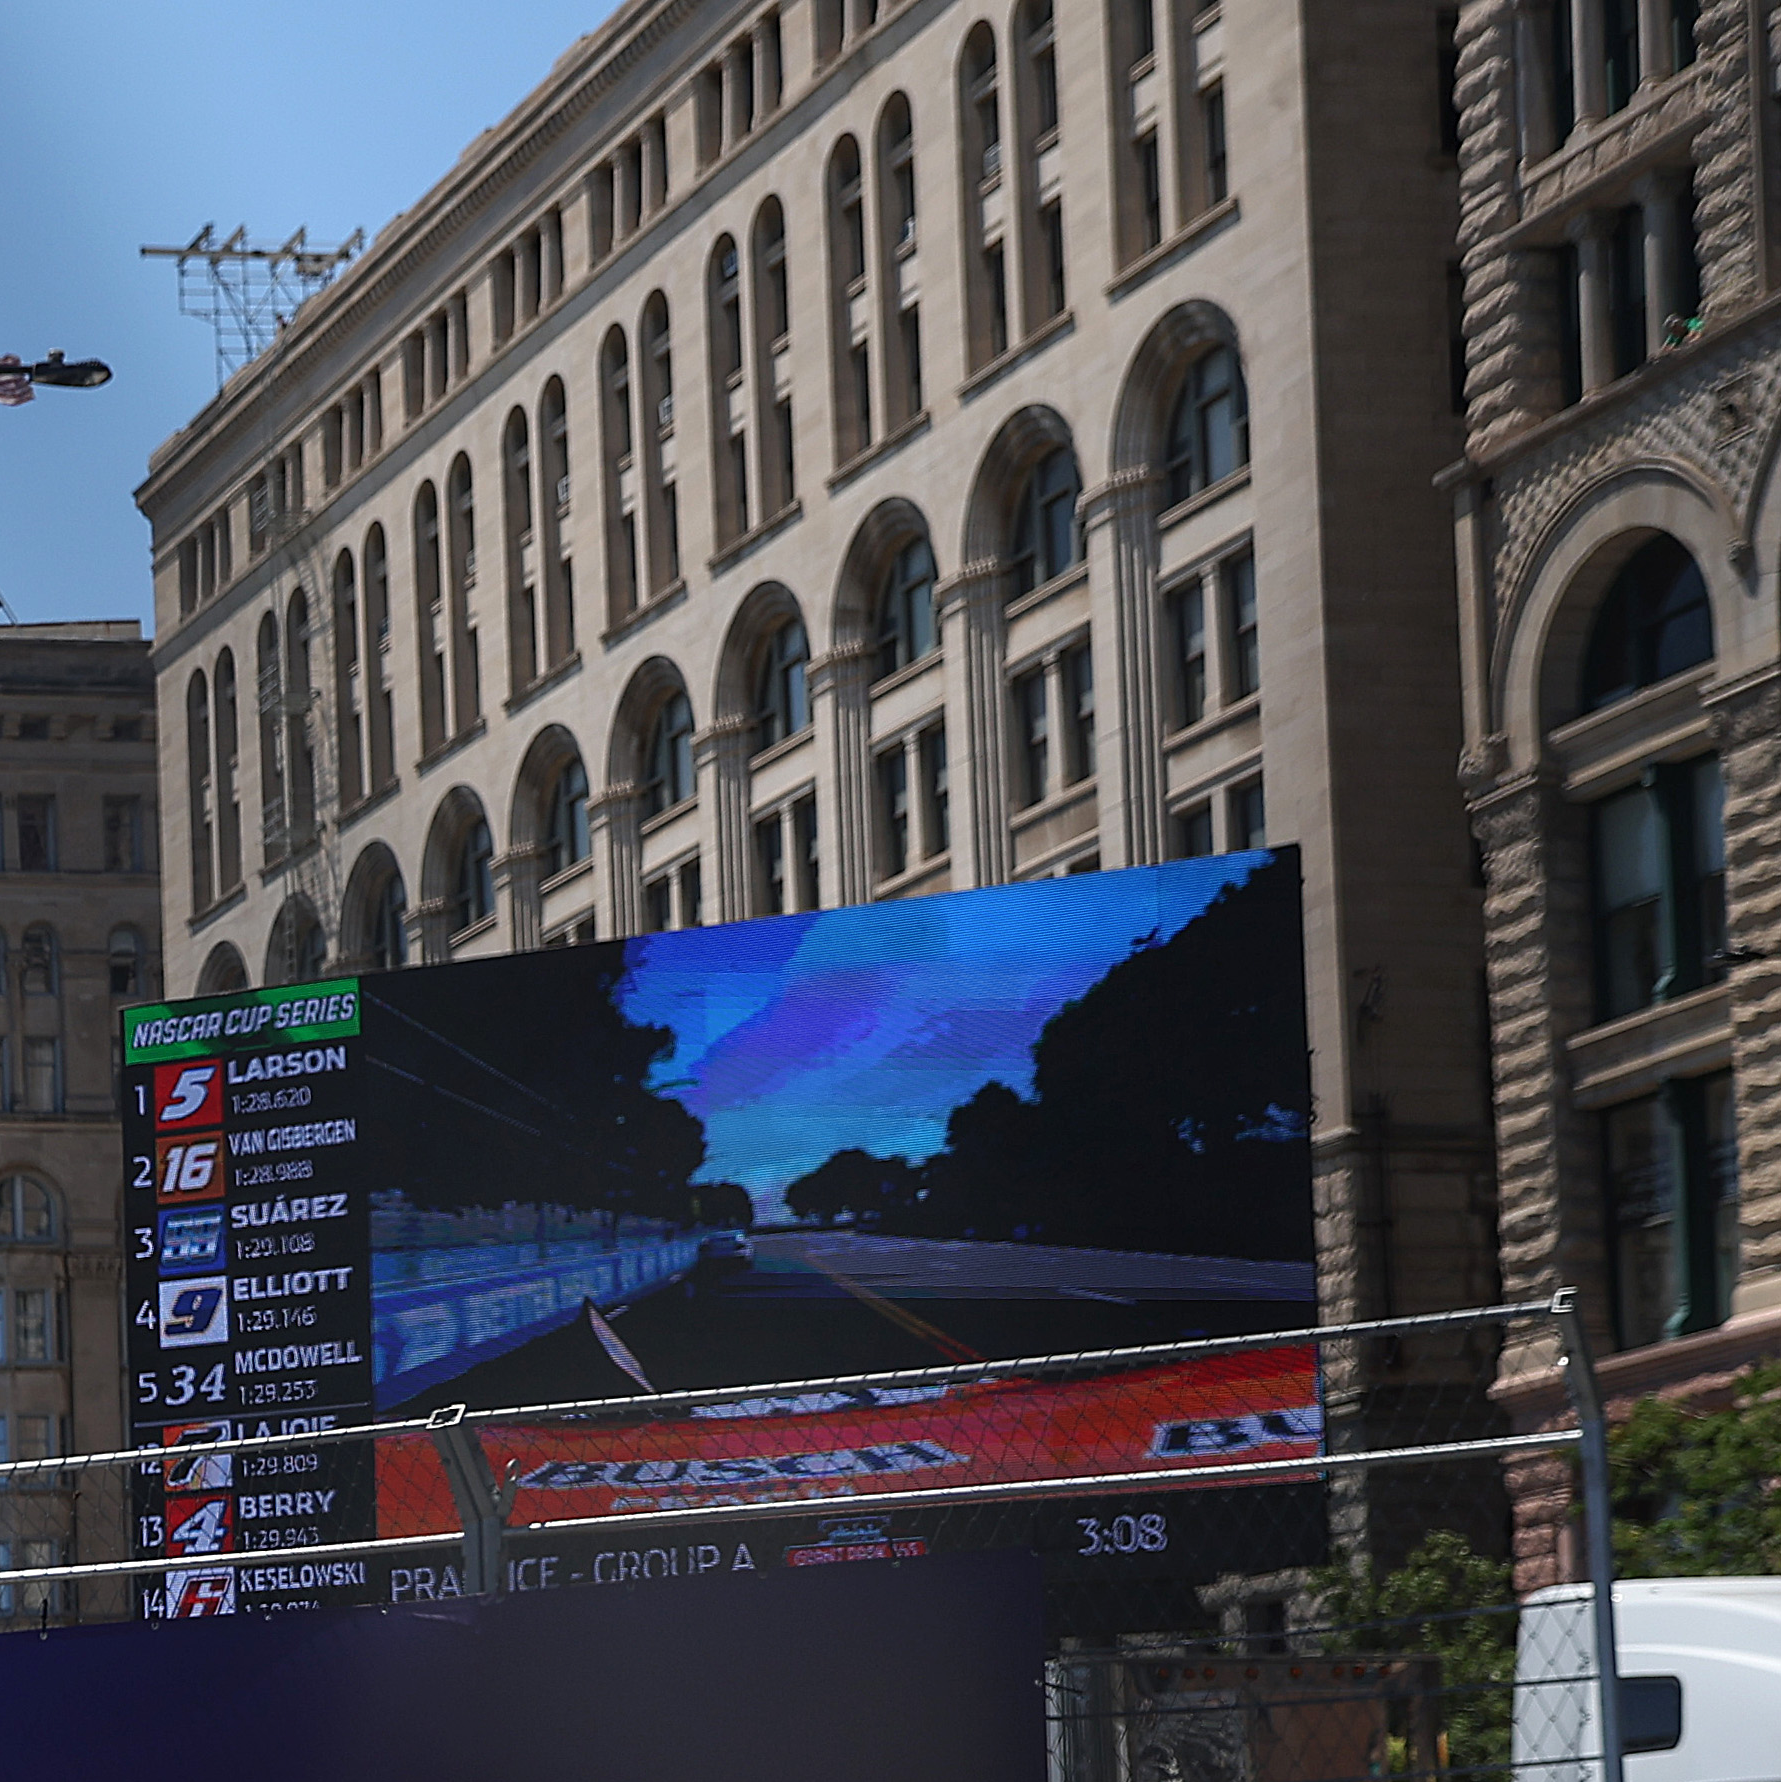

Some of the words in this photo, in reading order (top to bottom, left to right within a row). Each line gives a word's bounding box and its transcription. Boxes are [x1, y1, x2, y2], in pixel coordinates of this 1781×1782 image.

[132, 1011, 224, 1049] NASCAR
[224, 1004, 273, 1036] CUP
[274, 993, 357, 1030] SERIES
[133, 1085, 146, 1116] 1
[159, 1065, 218, 1123] 5
[227, 1045, 347, 1085] LARSON
[132, 1156, 153, 1189] 2
[162, 1142, 218, 1194] 16
[228, 1128, 265, 1157] VAN
[267, 1117, 357, 1152] GISBERGEN
[133, 1227, 155, 1260] 3
[230, 1193, 349, 1230] SUÁREZ
[135, 1299, 157, 1331] 4
[162, 1286, 224, 1339] 9
[232, 1265, 354, 1302] ELLIOTT
[138, 1371, 159, 1405] 5
[164, 1362, 228, 1407] 34
[234, 1340, 364, 1376] MCDOWELL
[139, 1515, 164, 1548] 13
[170, 1500, 229, 1555] 4
[238, 1489, 337, 1521] BERRY
[1076, 1513, 1168, 1556] 3:08
[143, 1587, 166, 1620] 14
[239, 1562, 367, 1594] KESELOWSKI
[390, 1555, 561, 1603] PRAICE
[731, 1542, 756, 1572] A
